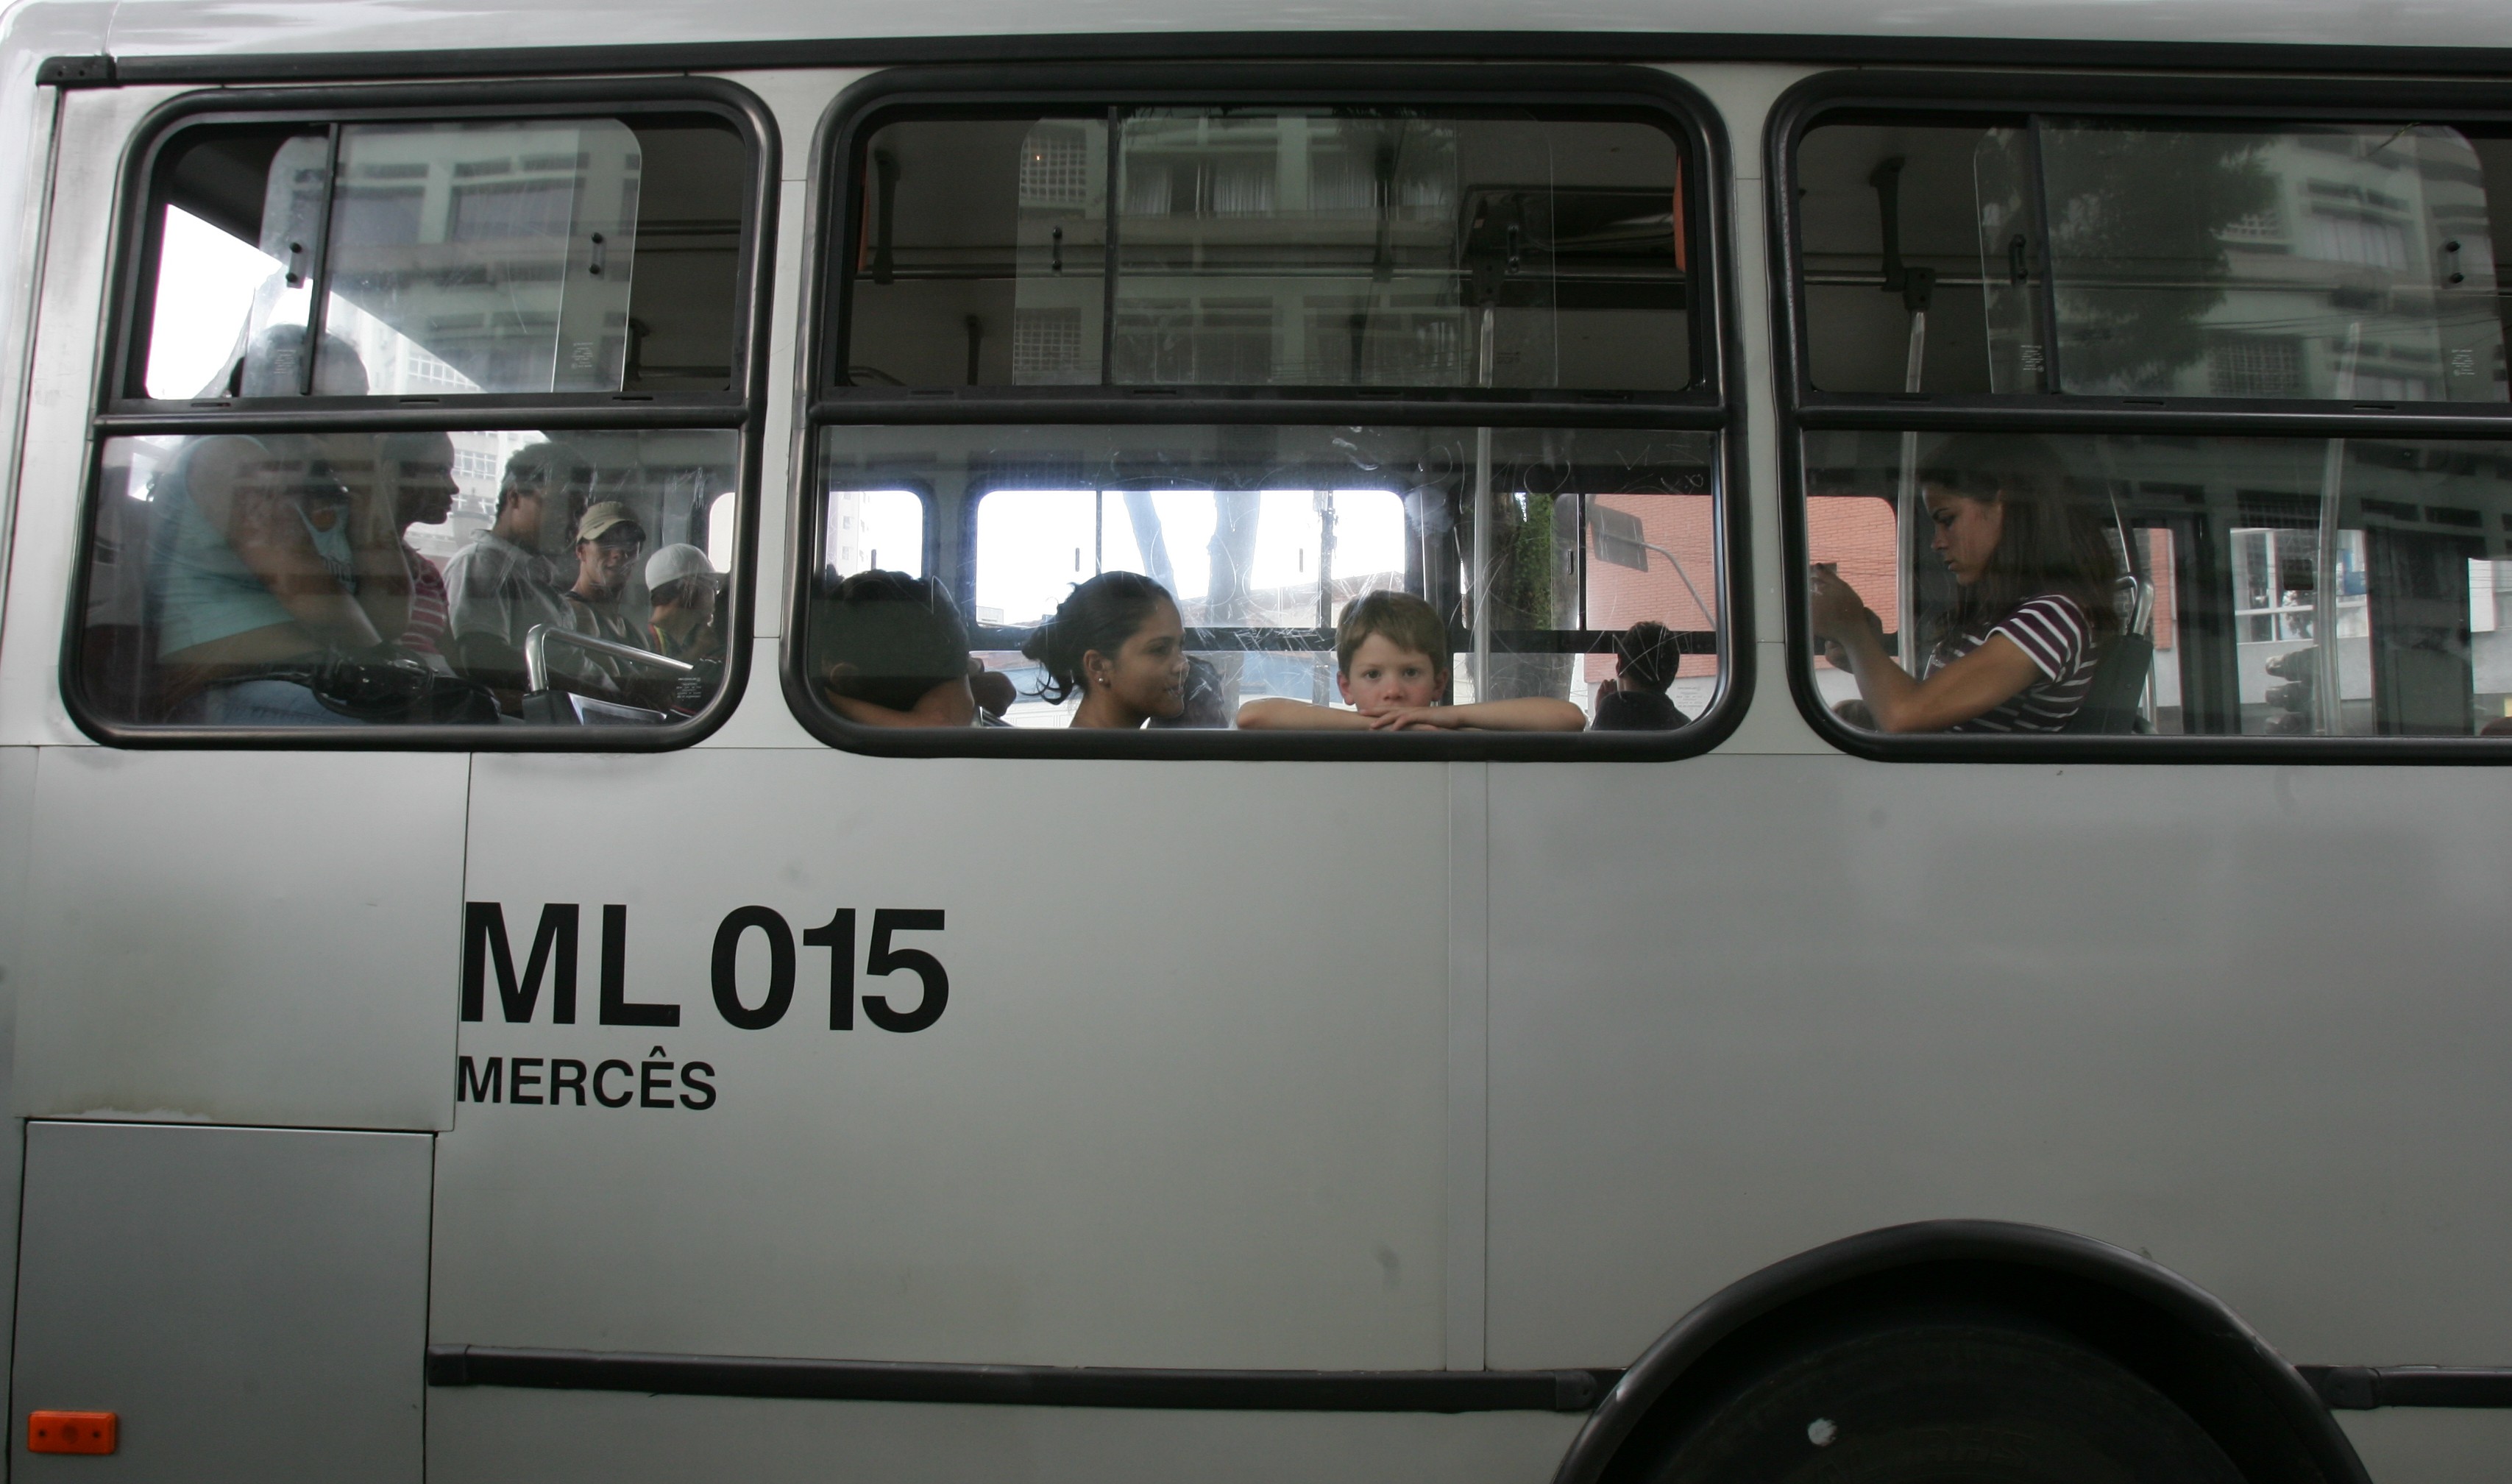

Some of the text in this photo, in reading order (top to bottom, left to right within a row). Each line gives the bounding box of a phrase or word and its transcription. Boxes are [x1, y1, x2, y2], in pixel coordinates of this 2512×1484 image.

[461, 901, 949, 1034] ML 015
[457, 1045, 717, 1111] MERCÊS
